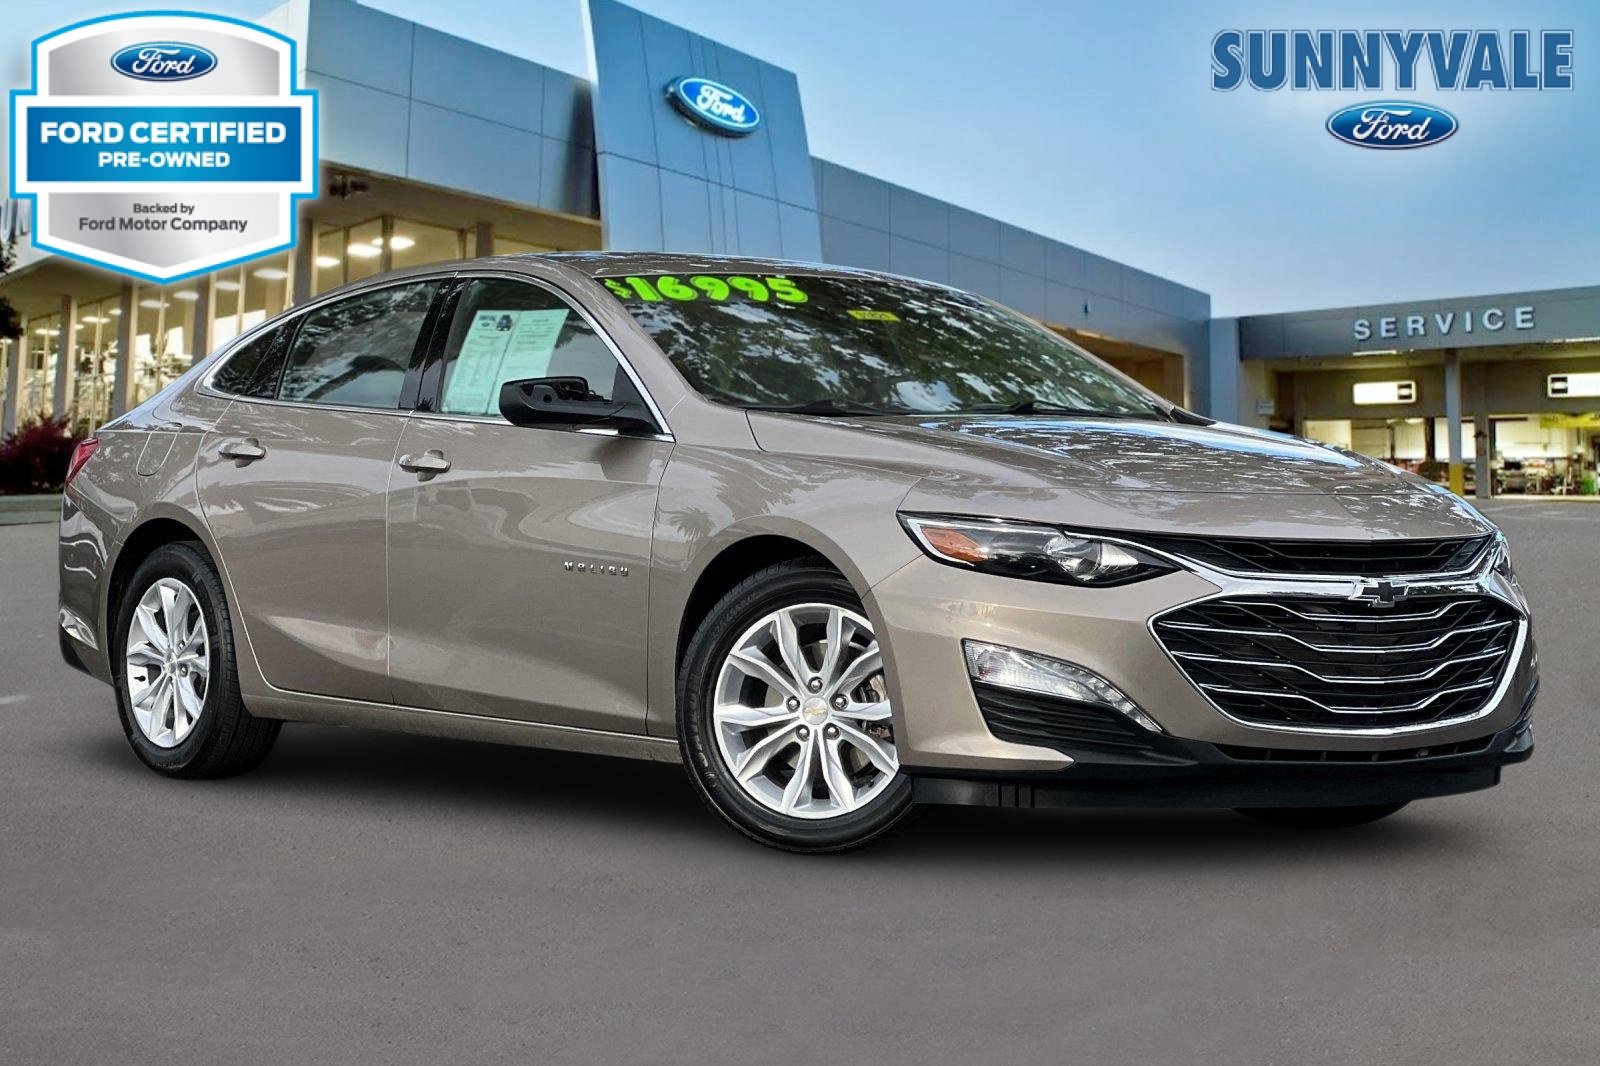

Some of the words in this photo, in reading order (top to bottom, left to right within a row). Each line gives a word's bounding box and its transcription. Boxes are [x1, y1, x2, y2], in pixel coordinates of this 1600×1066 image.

[697, 85, 746, 123] Ford
[604, 275, 809, 303] $16995
[1353, 306, 1536, 341] SERVICE
